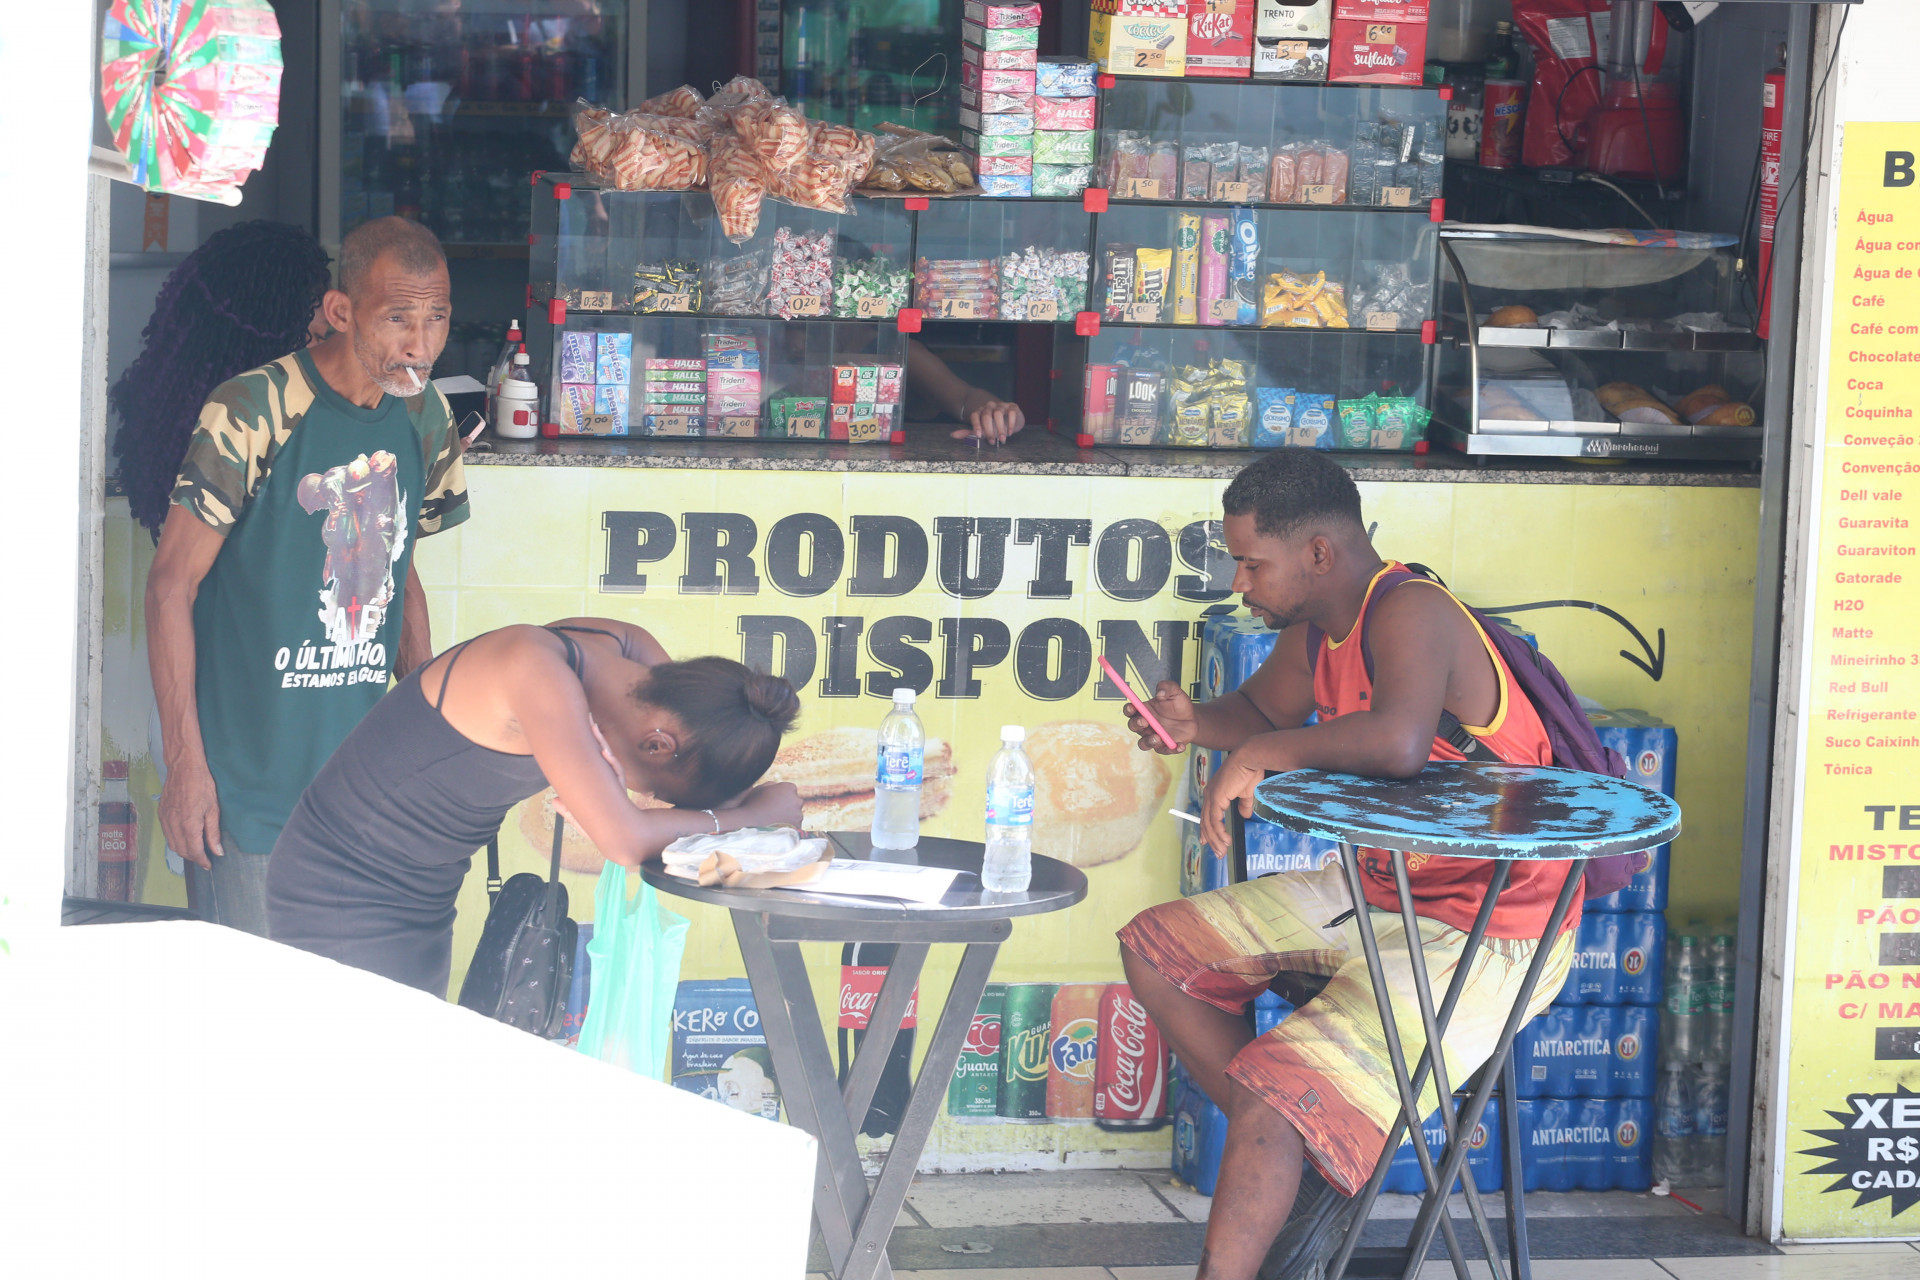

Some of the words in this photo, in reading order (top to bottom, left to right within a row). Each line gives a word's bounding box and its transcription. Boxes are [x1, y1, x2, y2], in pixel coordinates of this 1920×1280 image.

[1264, 9, 1295, 18] TRENTO
[1197, 13, 1230, 38] KitKat
[1261, 52, 1278, 61] TRE
[1353, 52, 1396, 68] suflair
[1057, 109, 1092, 119] HALLS
[1056, 142, 1090, 152] HALLS
[993, 182, 1018, 190] Trident
[1054, 175, 1089, 185] HALLS
[1856, 208, 1894, 226] Água
[1855, 236, 1892, 254] Água
[1853, 265, 1890, 282] Água
[1895, 267, 1913, 279] de
[1852, 295, 1886, 307] Café
[1850, 323, 1884, 335] Café
[1888, 325, 1919, 335] com
[568, 334, 589, 381] mentos
[605, 335, 624, 382] mentos
[673, 359, 702, 368] HALLS
[1849, 351, 1920, 363] Chocolate
[720, 376, 745, 384] Trident
[1847, 379, 1884, 391] Coca
[671, 383, 700, 391] HALLS
[1130, 381, 1157, 401] LOOK
[672, 394, 701, 402] HALLS
[720, 400, 746, 408] Trident
[606, 387, 625, 434] mentos
[671, 406, 700, 414] HALLS
[1845, 406, 1913, 421] Coquinha
[1844, 433, 1914, 448] Conveção
[1842, 461, 1920, 476] Convenção
[1840, 489, 1868, 501] Dell
[1873, 489, 1903, 501] vale
[1838, 517, 1909, 529] Guaravita
[598, 511, 1234, 600] PRODUTOS
[1837, 545, 1916, 557] Guaraviton
[1835, 572, 1902, 584] Gatorade
[1834, 600, 1865, 611] H2O
[1832, 627, 1873, 639] Matte
[274, 646, 291, 671] O
[1830, 654, 1906, 666] Mineirinho
[281, 672, 346, 688] ESTAMOS
[1829, 681, 1856, 693] Red
[1861, 681, 1888, 693] Bull
[1827, 708, 1917, 724] Refrigerante
[1825, 735, 1861, 748] Suco
[1824, 762, 1873, 775] Tônica
[101, 830, 123, 838] matte
[1571, 952, 1617, 970] RCTICA
[1825, 969, 1890, 990] PÃO
[563, 1005, 588, 1027] ed
[1838, 1002, 1868, 1020] C/
[733, 1005, 760, 1032] CO
[1107, 993, 1147, 1112] Coca-Cola
[1532, 1039, 1611, 1058] ANTARCTICA
[1531, 1127, 1611, 1146] ANTARCTICA
